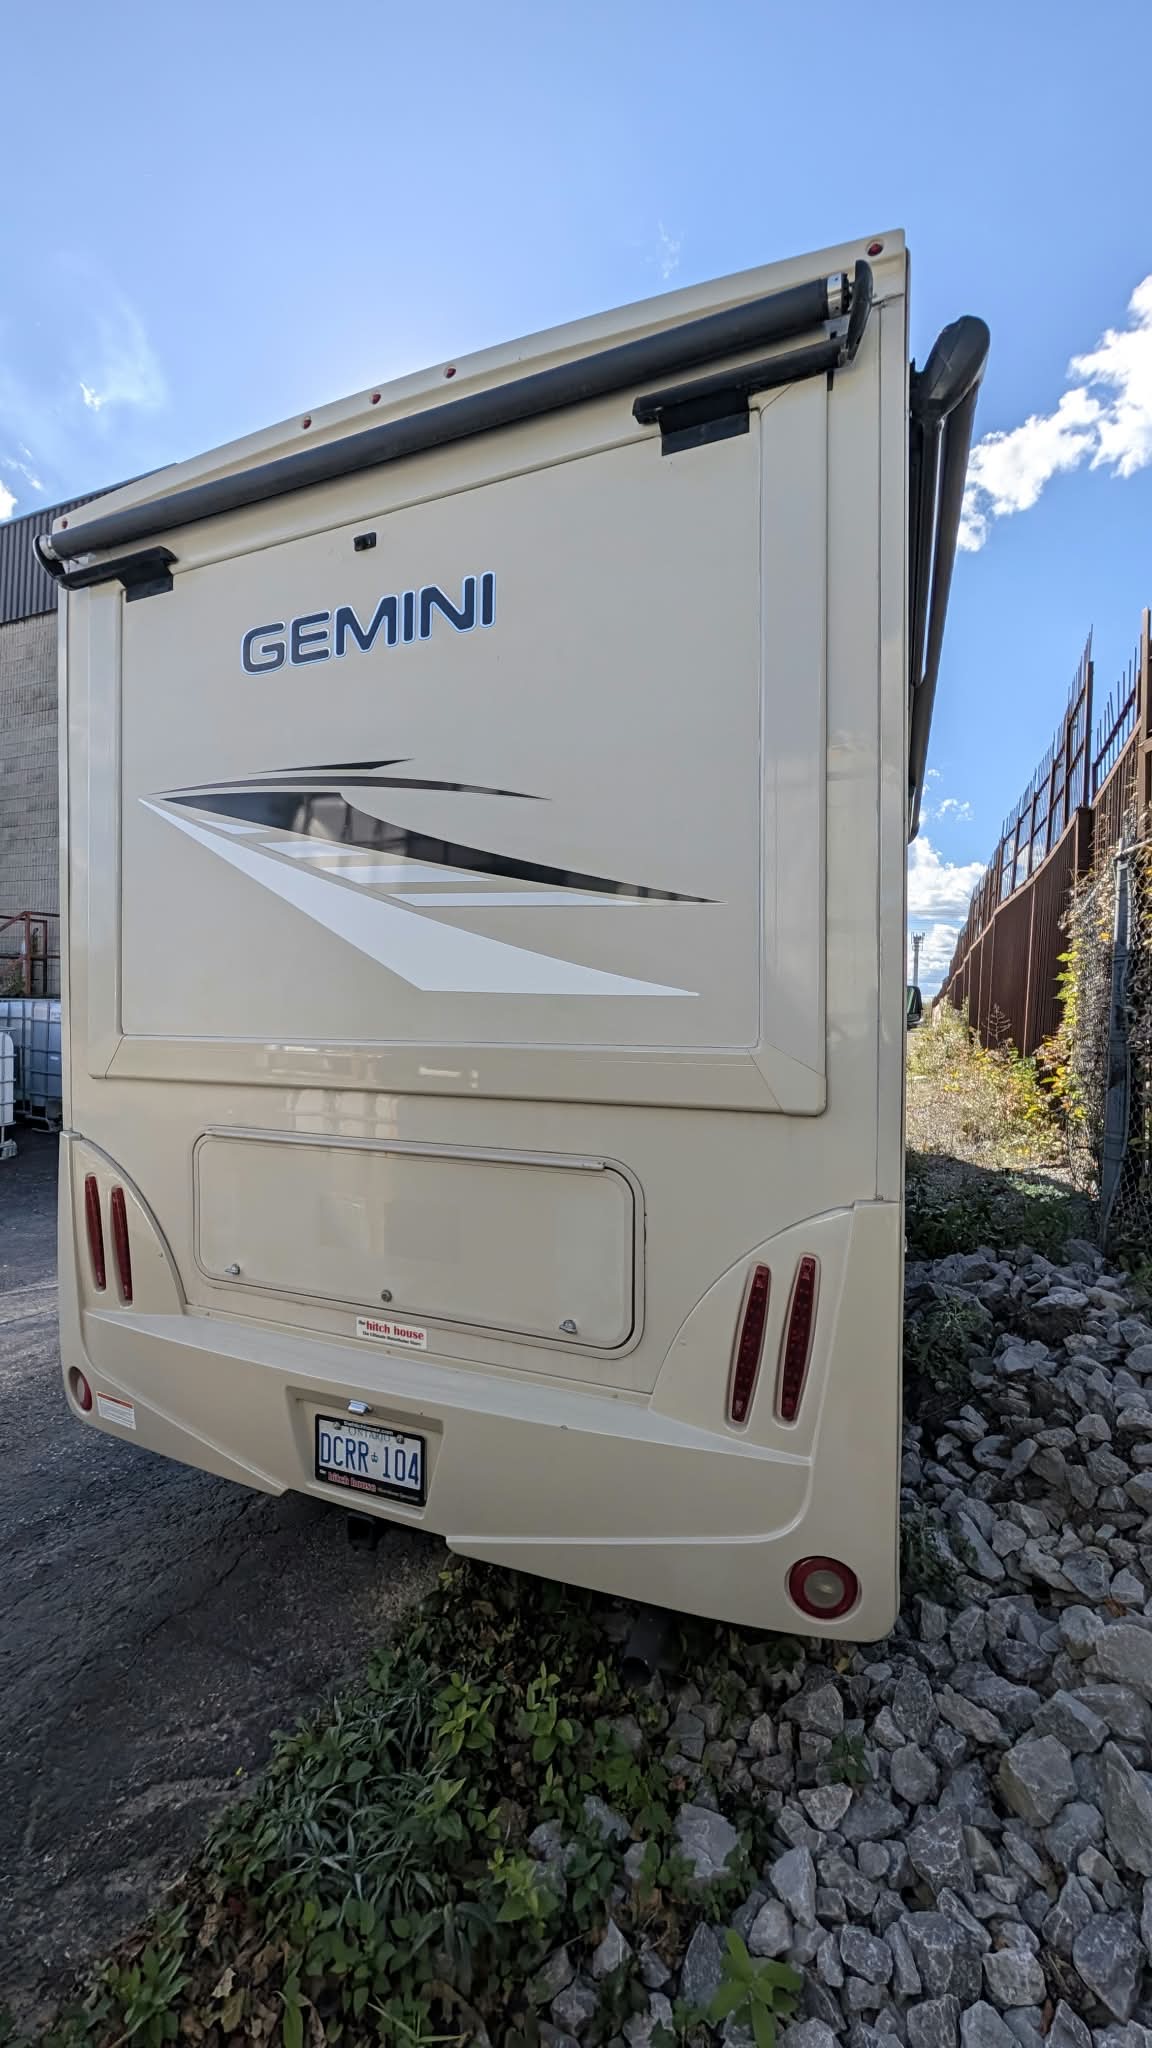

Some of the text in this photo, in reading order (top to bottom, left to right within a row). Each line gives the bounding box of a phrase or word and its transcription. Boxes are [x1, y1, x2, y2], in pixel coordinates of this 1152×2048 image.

[240, 570, 496, 675] GEMINI
[366, 1321, 390, 1334] hitch
[393, 1326, 424, 1340] house
[348, 1427, 391, 1442] ONTARIO
[320, 1432, 420, 1486] DCRR 104
[327, 1471, 350, 1486] hitch
